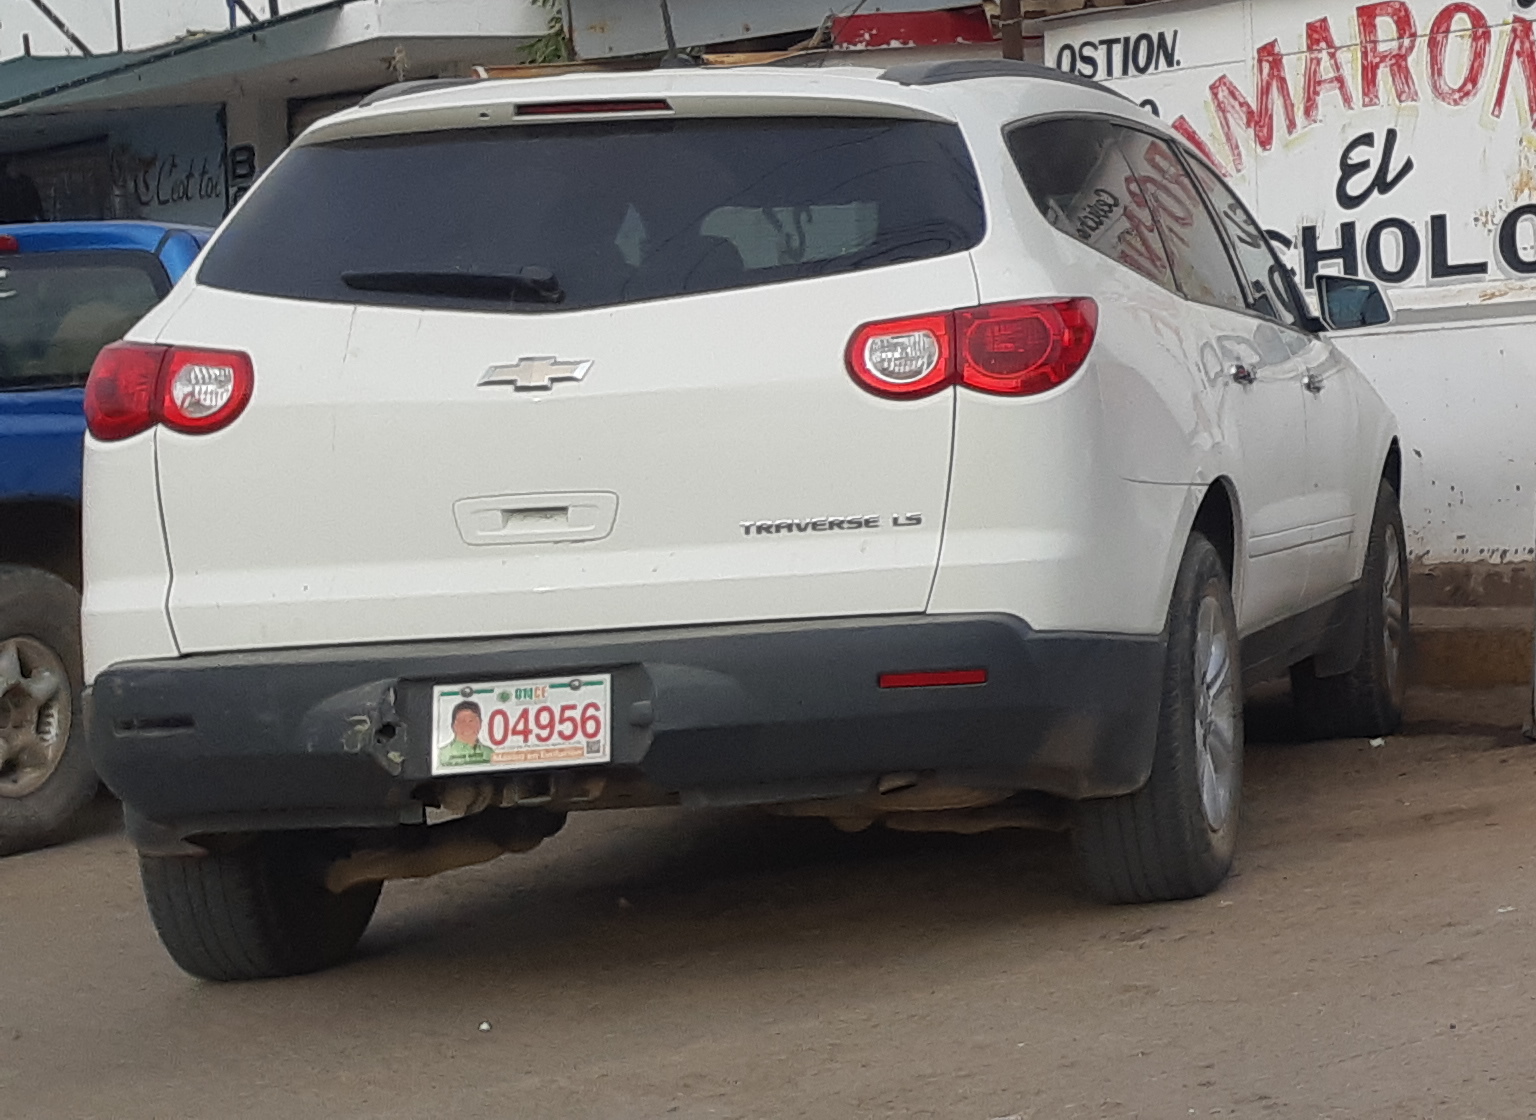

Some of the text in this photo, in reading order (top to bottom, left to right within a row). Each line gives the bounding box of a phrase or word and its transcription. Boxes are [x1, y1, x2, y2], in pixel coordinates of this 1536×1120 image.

[1056, 29, 1182, 80] OSTION.
[1334, 127, 1415, 211] El
[739, 511, 923, 536] TRAVERSE LS
[487, 701, 602, 747] 04956
